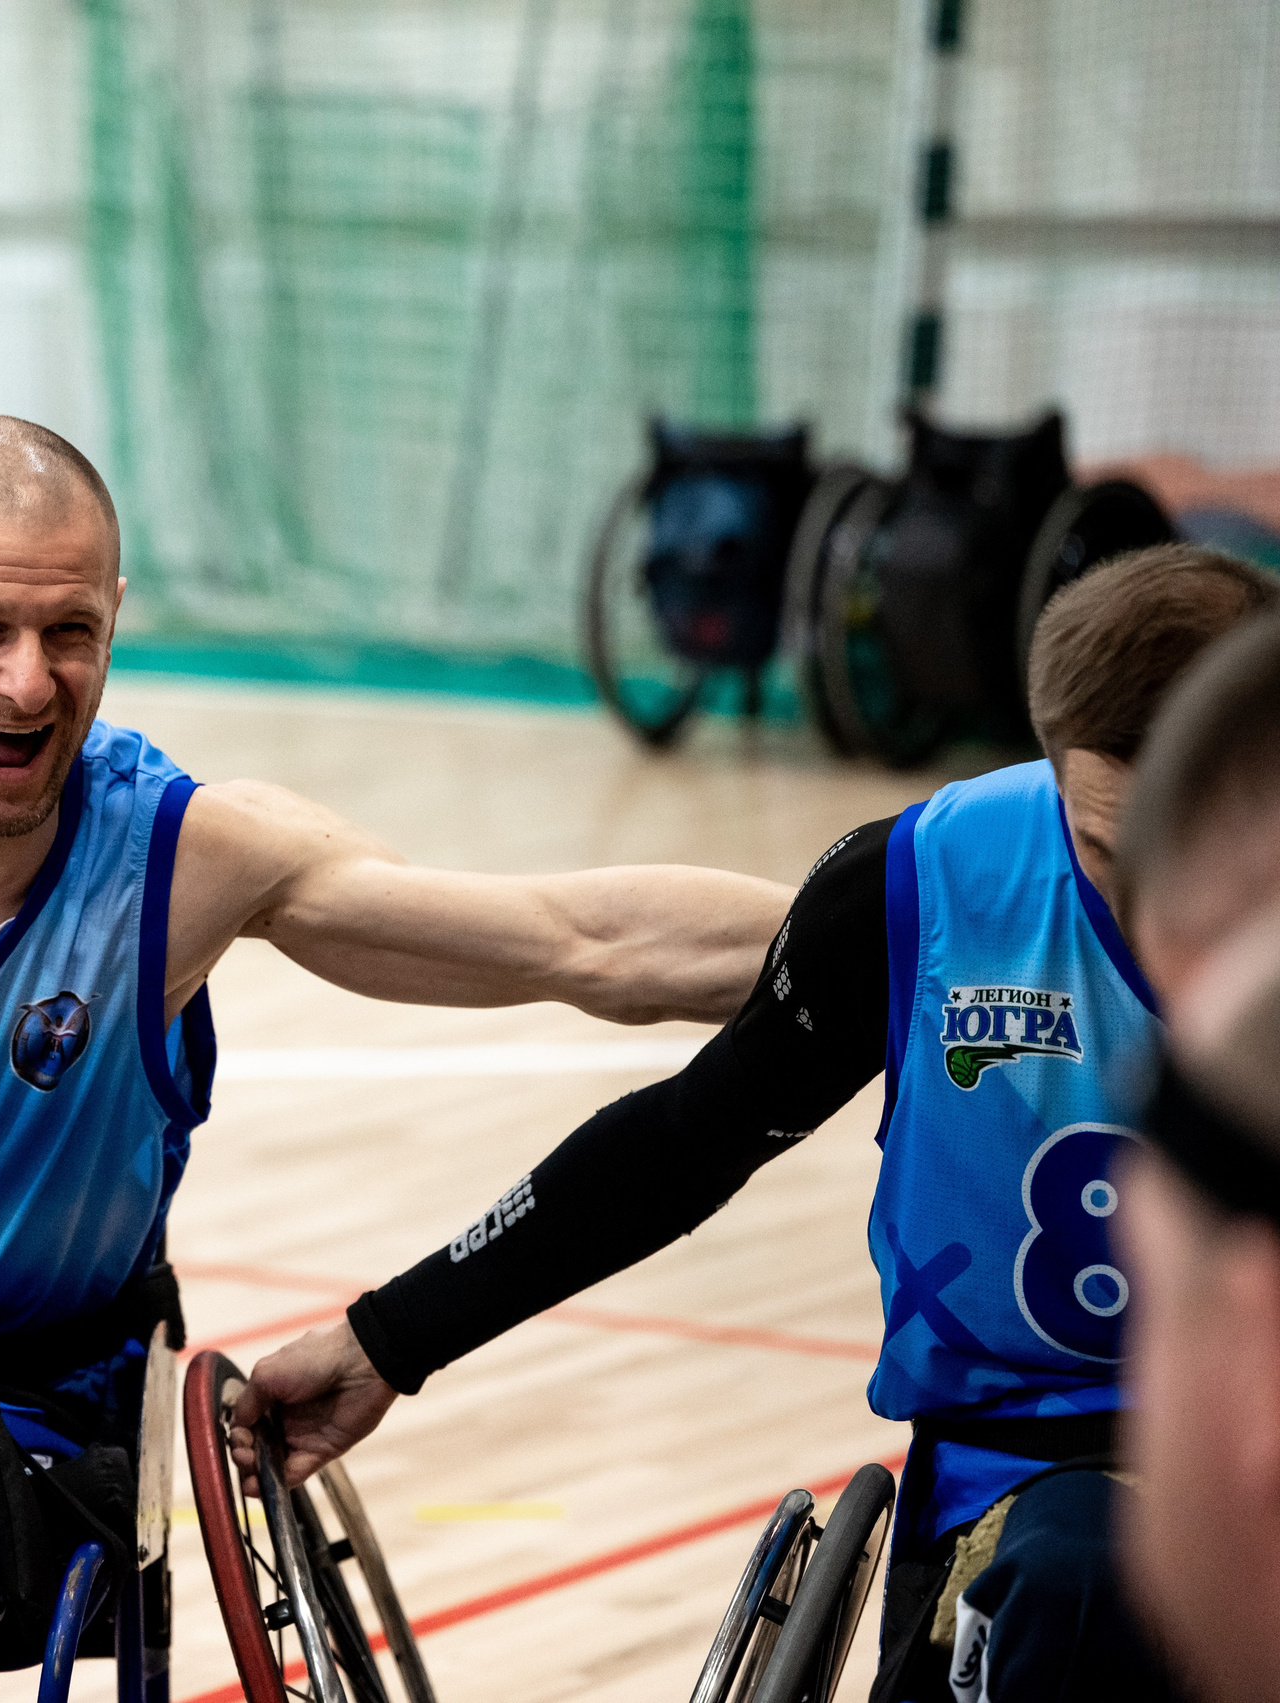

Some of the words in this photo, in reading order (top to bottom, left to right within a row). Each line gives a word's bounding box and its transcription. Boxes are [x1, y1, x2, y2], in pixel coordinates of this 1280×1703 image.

[969, 988, 1052, 1008] ЛЕГИОН
[941, 1004, 1082, 1055] ЮГРА
[1013, 1121, 1150, 1365] 8
